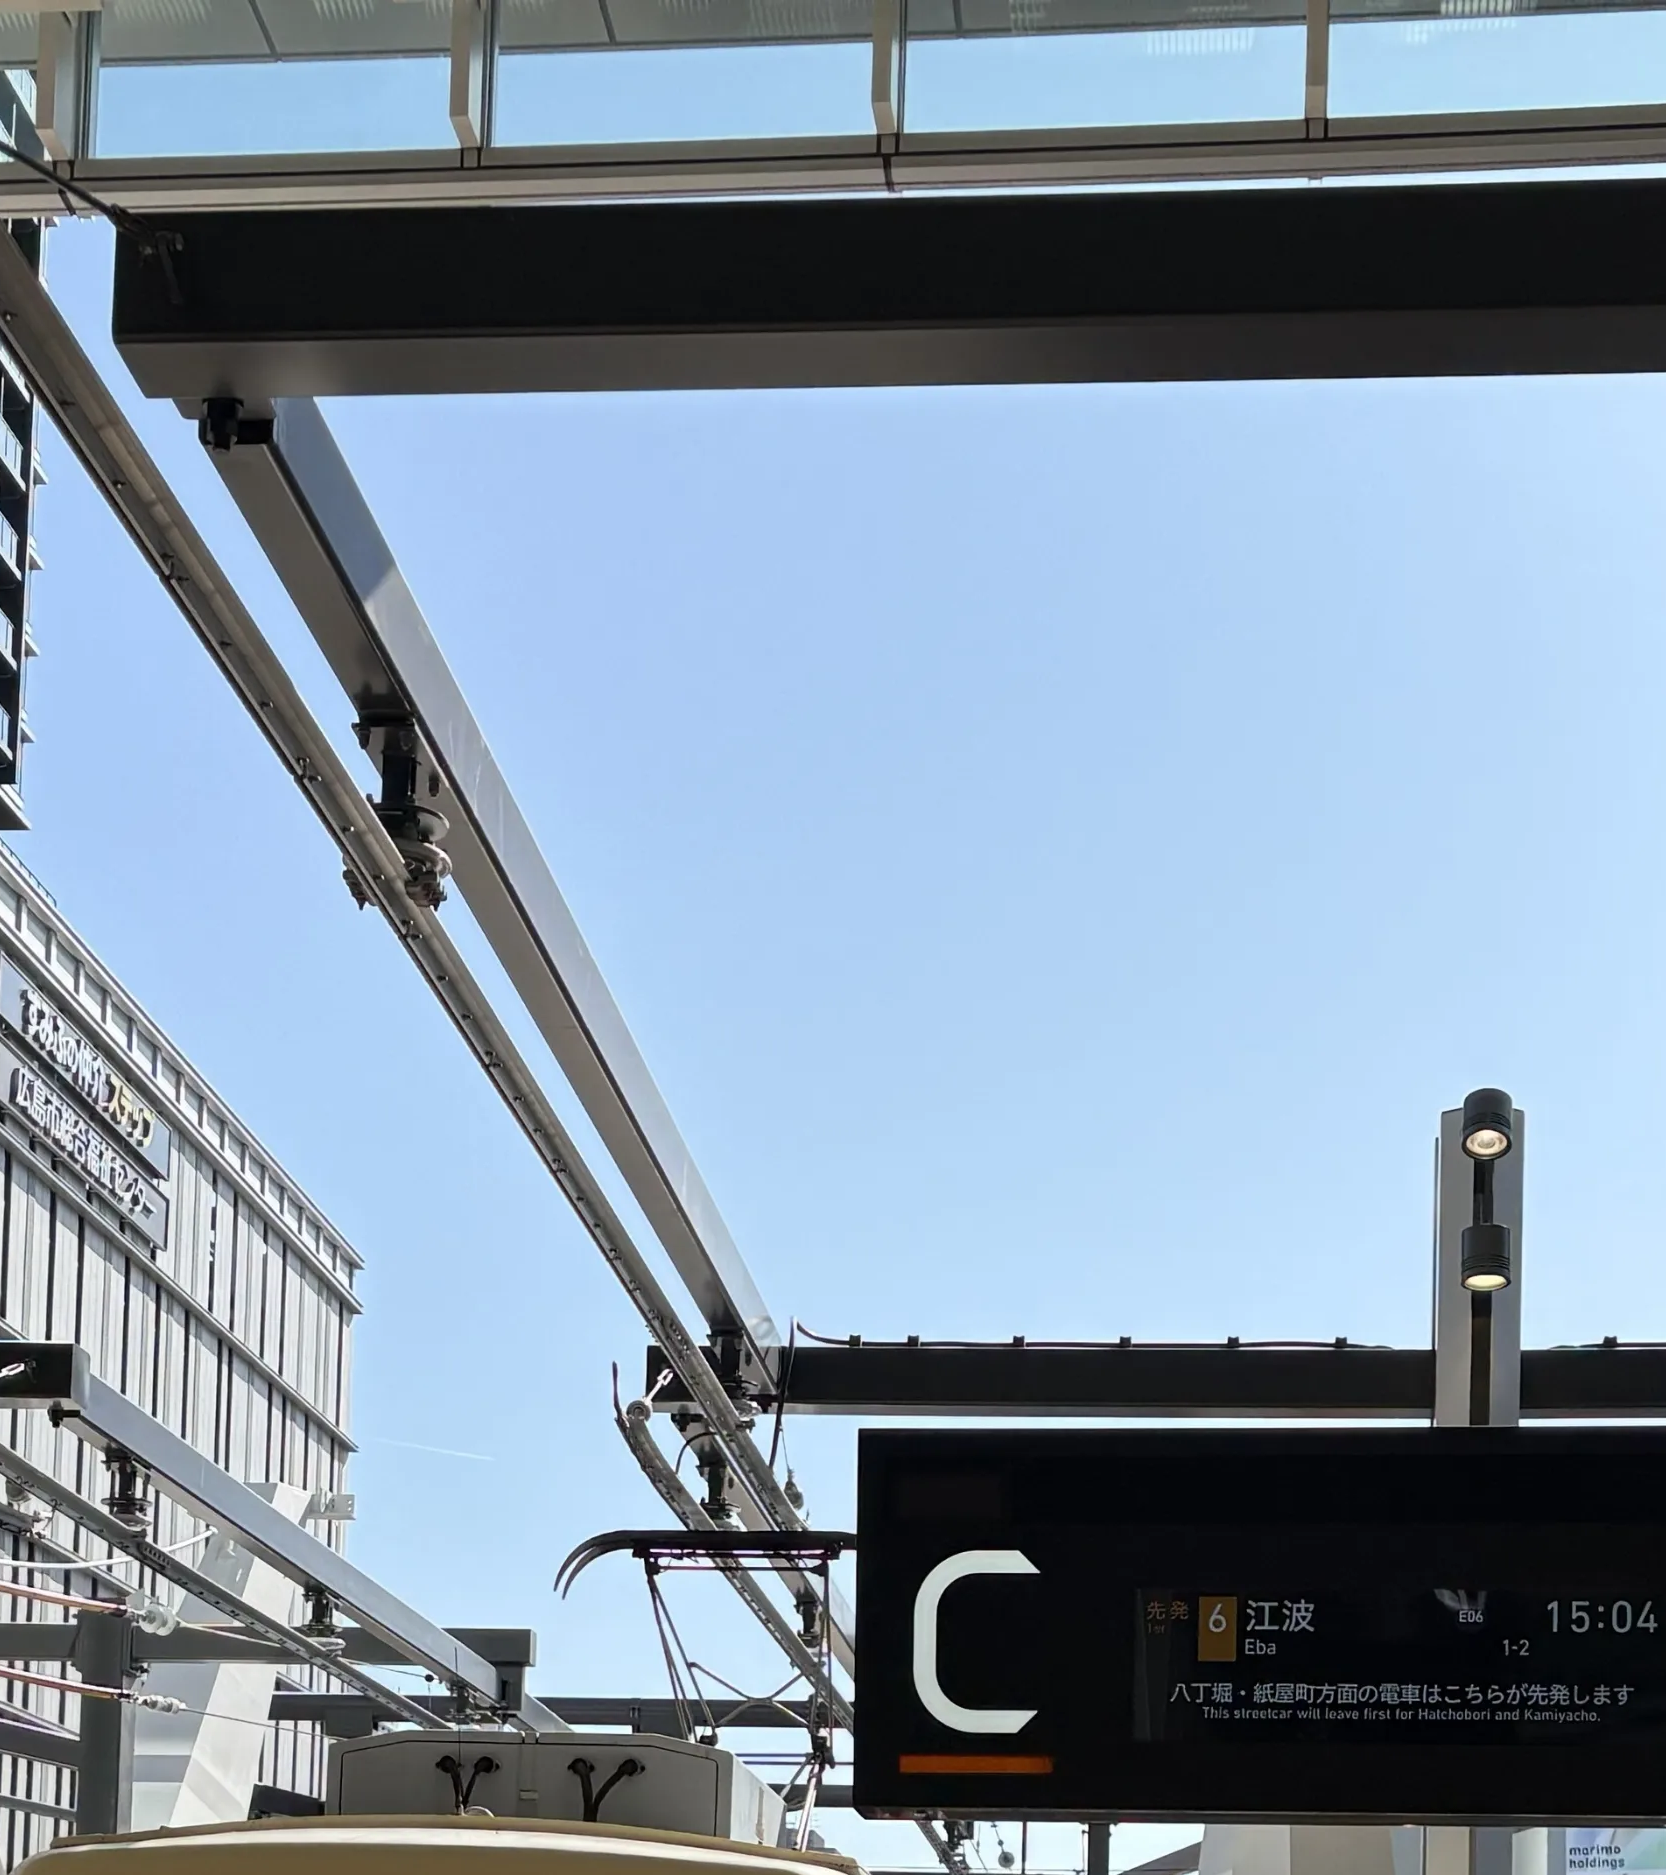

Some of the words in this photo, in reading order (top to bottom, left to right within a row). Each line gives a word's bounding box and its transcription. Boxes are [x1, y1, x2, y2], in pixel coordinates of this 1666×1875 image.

[1208, 1604, 1227, 1633] 6
[1245, 1599, 1316, 1634] 江波
[1459, 1609, 1484, 1623] E06
[1546, 1600, 1659, 1634] 15:04
[912, 1549, 1041, 1734] C
[1245, 1639, 1277, 1656] Eba
[1503, 1639, 1530, 1656] 1-2
[1203, 1706, 1231, 1720] This
[1297, 1706, 1320, 1720] will
[1396, 1706, 1414, 1720] for
[1495, 1706, 1519, 1720] and
[1569, 1844, 1622, 1856] marimo
[1569, 1857, 1626, 1871] holdings
